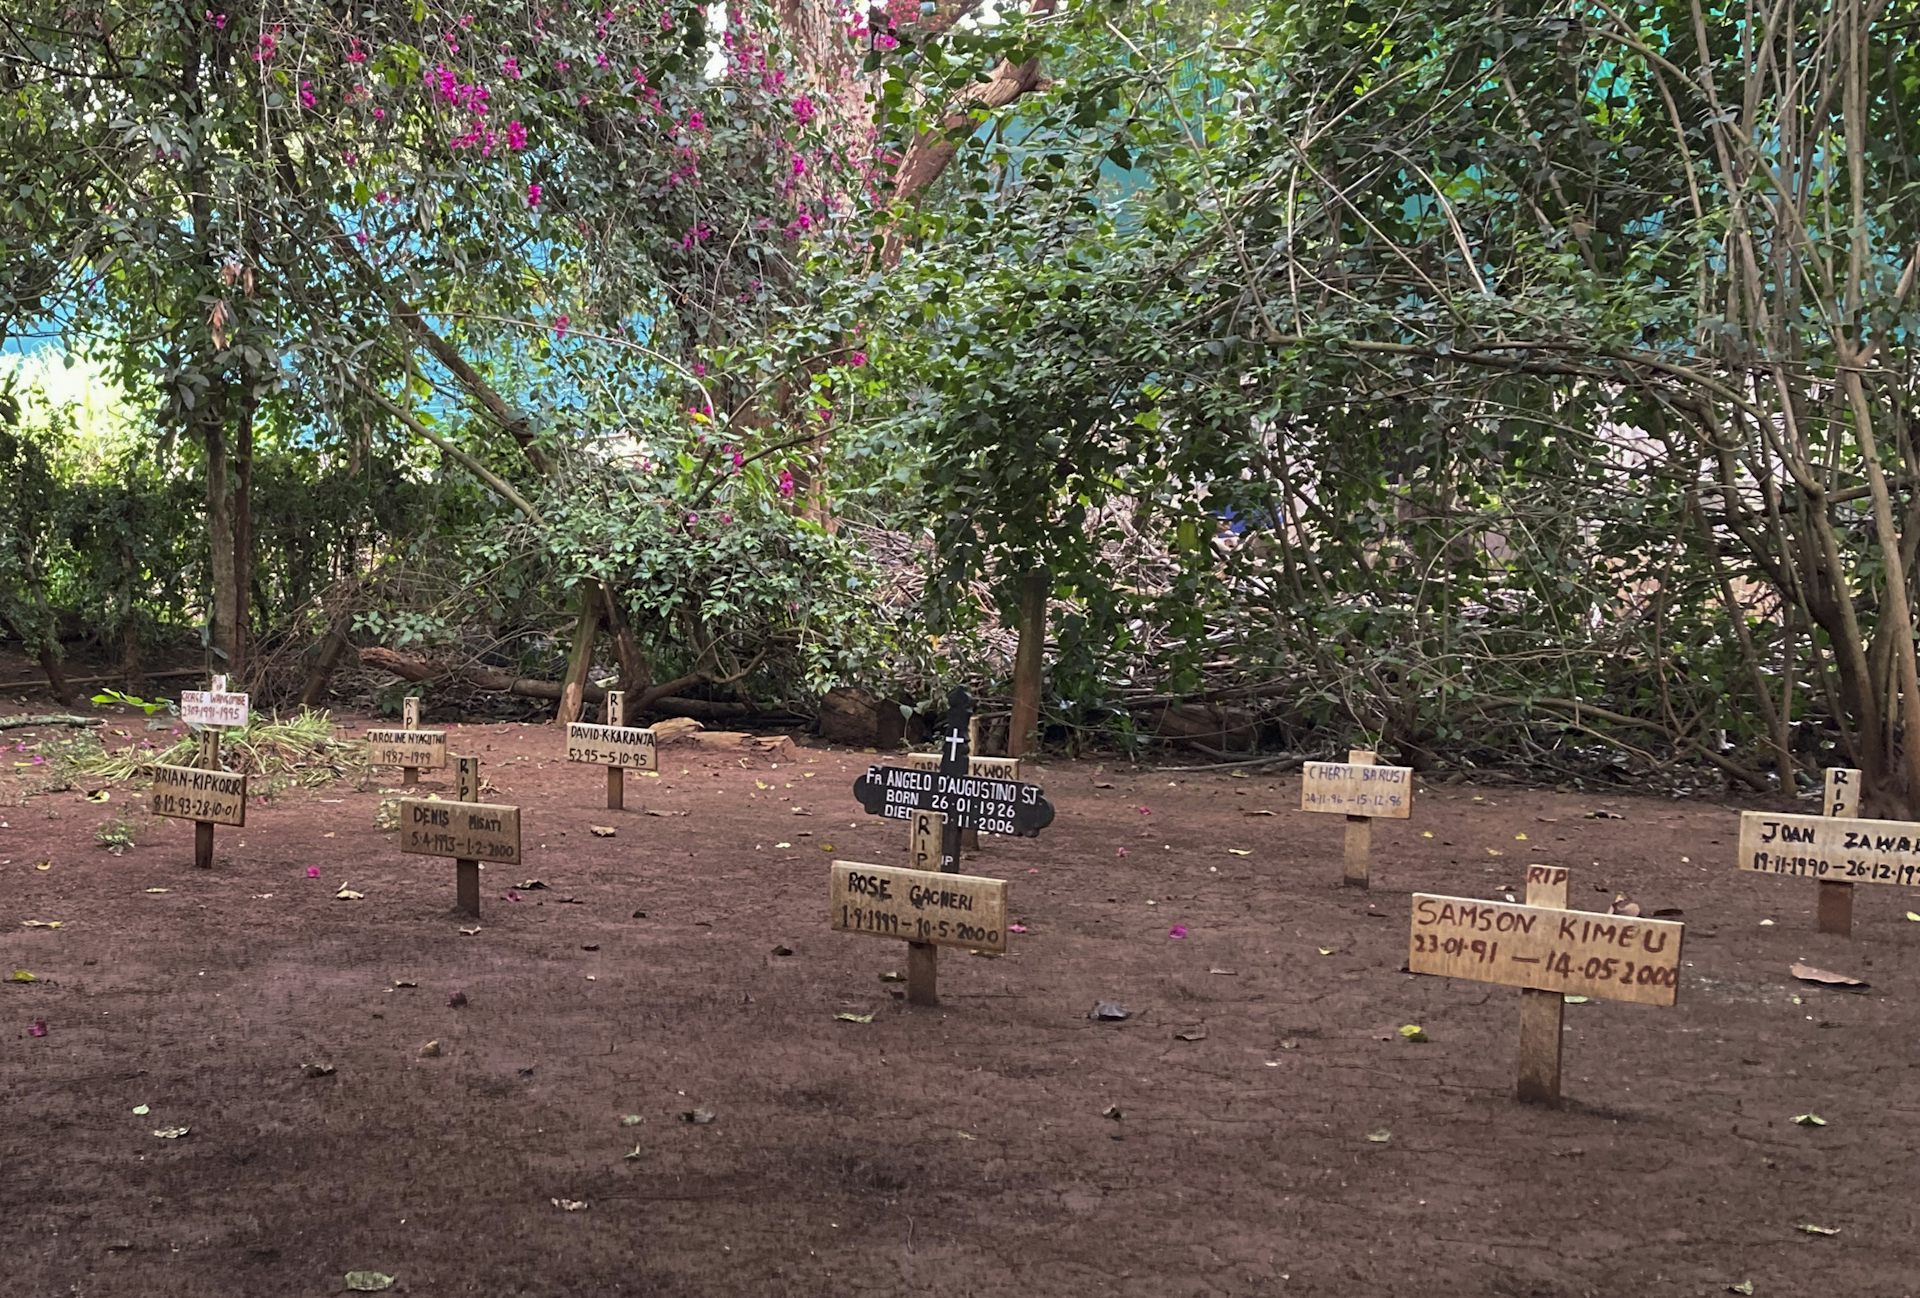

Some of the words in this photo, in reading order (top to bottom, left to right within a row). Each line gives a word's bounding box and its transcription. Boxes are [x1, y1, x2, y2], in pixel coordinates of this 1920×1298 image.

[1310, 765, 1356, 780] CHERYL
[886, 789, 919, 806] BORN
[887, 770, 931, 791] ANGELO
[1022, 784, 1039, 805] SJ
[414, 807, 449, 828] DENIS
[1762, 822, 1816, 843] JOAN
[849, 872, 893, 900] ROSE
[1527, 867, 1567, 885] RIP
[1418, 900, 1537, 934] SAMSON
[1559, 917, 1667, 953] KIMEU
